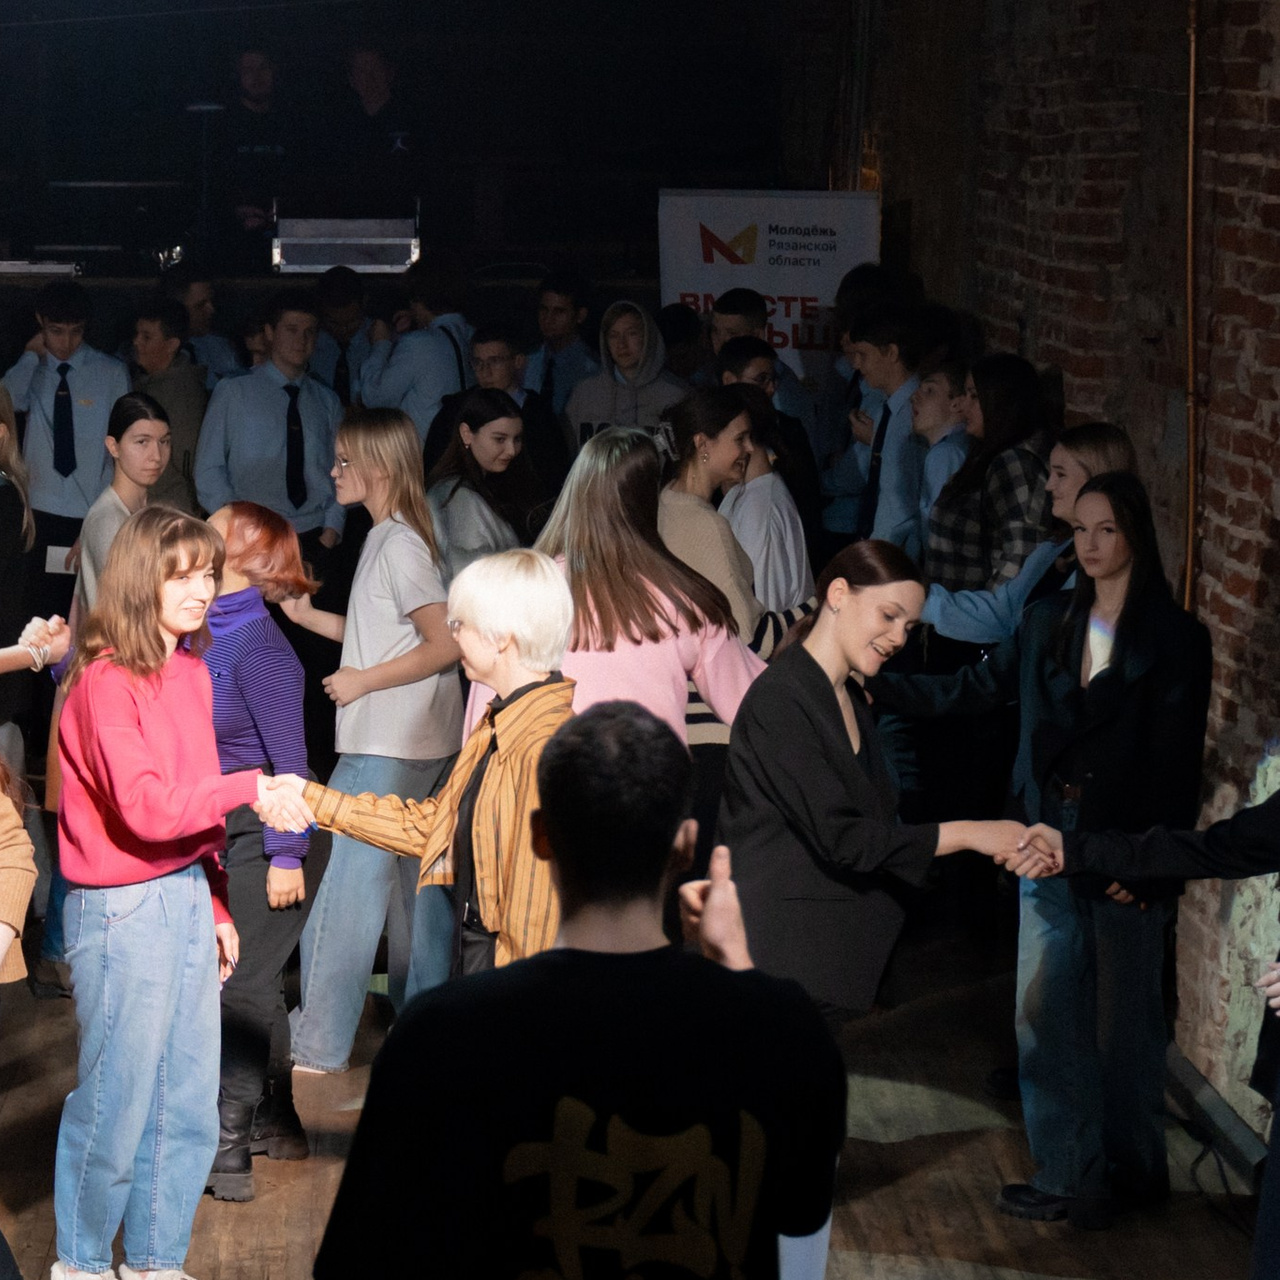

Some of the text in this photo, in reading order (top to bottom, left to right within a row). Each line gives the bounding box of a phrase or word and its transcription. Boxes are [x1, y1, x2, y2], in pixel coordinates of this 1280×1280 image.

[768, 223, 837, 238] Молодёжь
[768, 239, 837, 252] Рязанской
[768, 254, 821, 266] области
